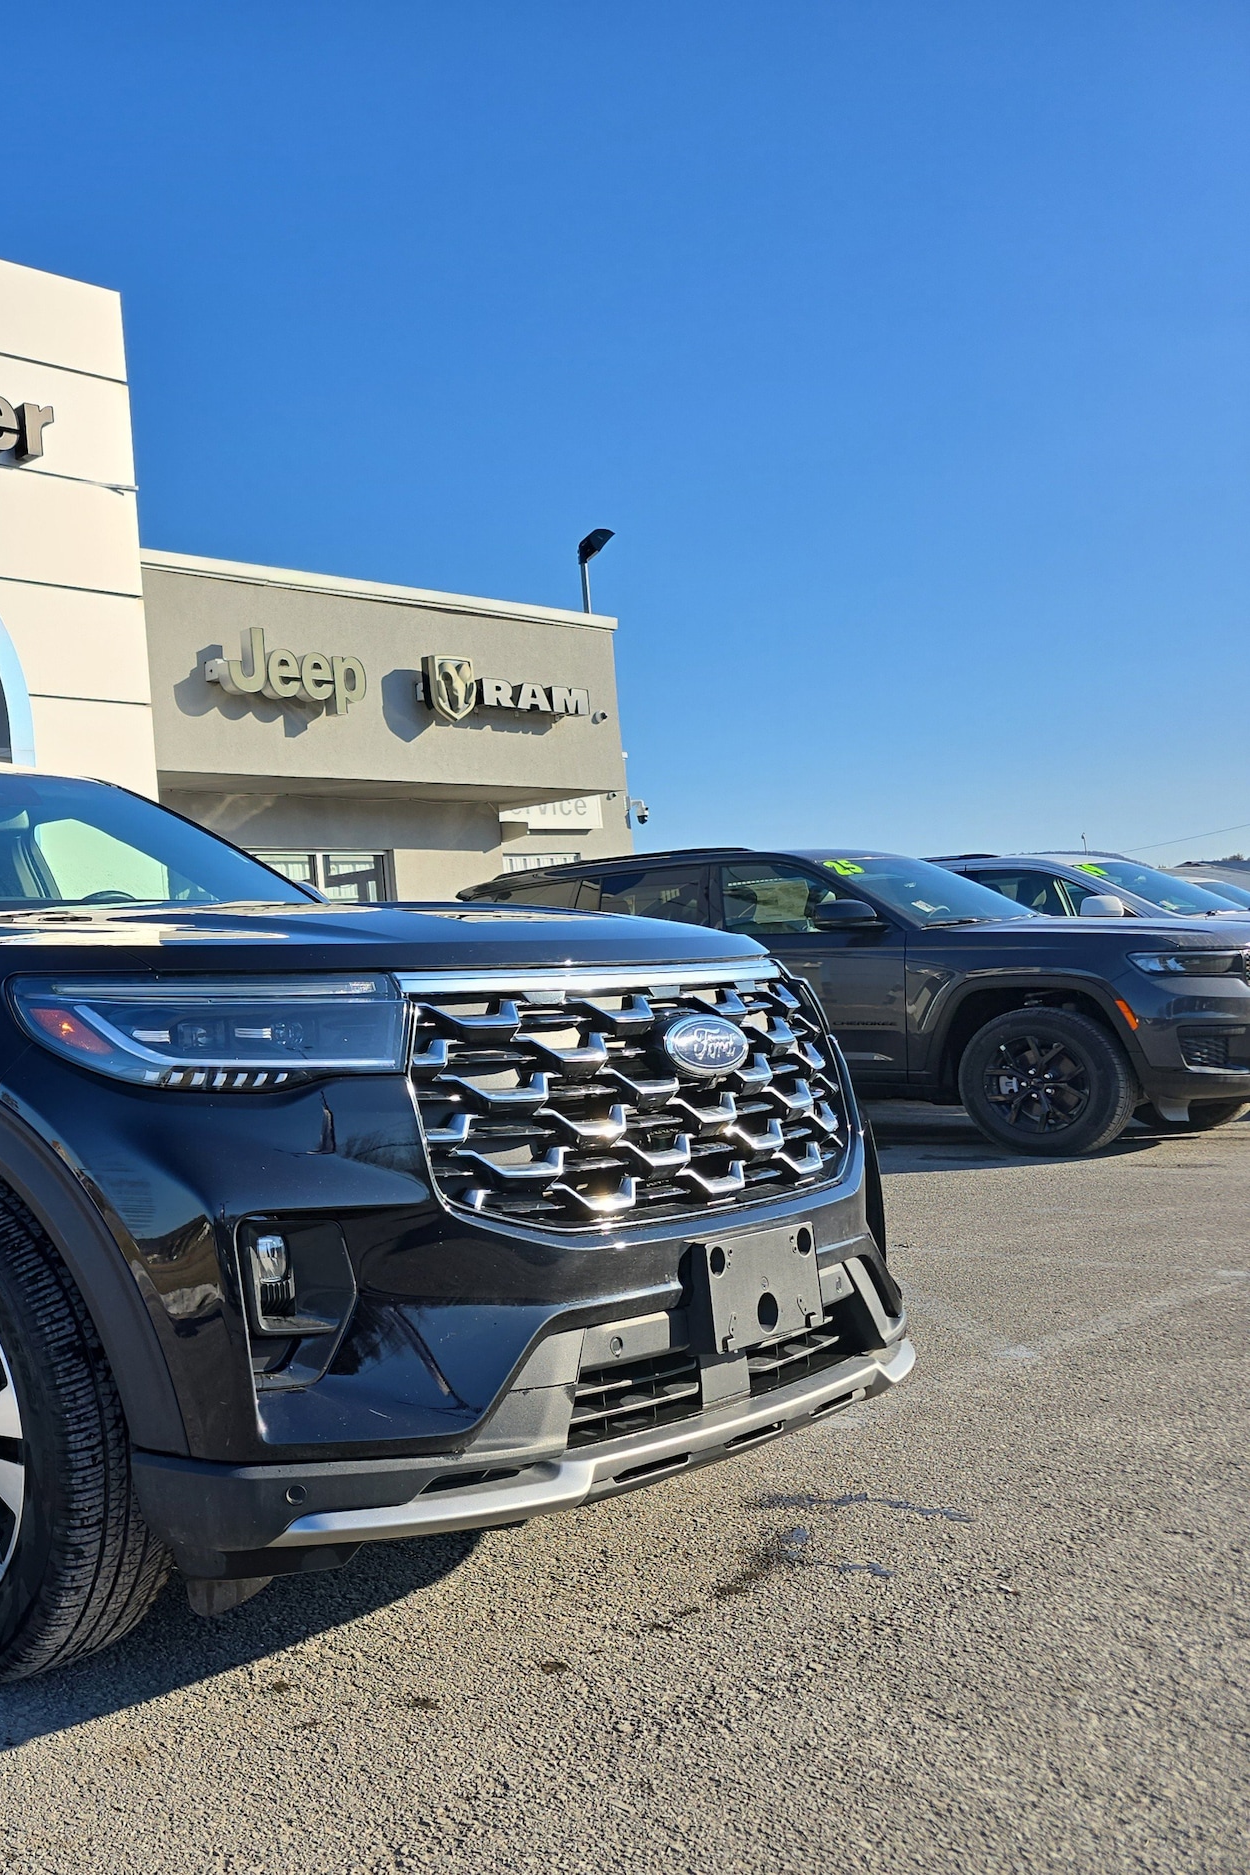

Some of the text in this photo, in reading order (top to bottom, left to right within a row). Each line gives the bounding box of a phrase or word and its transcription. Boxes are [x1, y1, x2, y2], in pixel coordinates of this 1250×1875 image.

[220, 626, 367, 716] Jeep
[479, 677, 590, 716] RAM
[822, 859, 865, 876] 25
[693, 1027, 736, 1060] Ford
